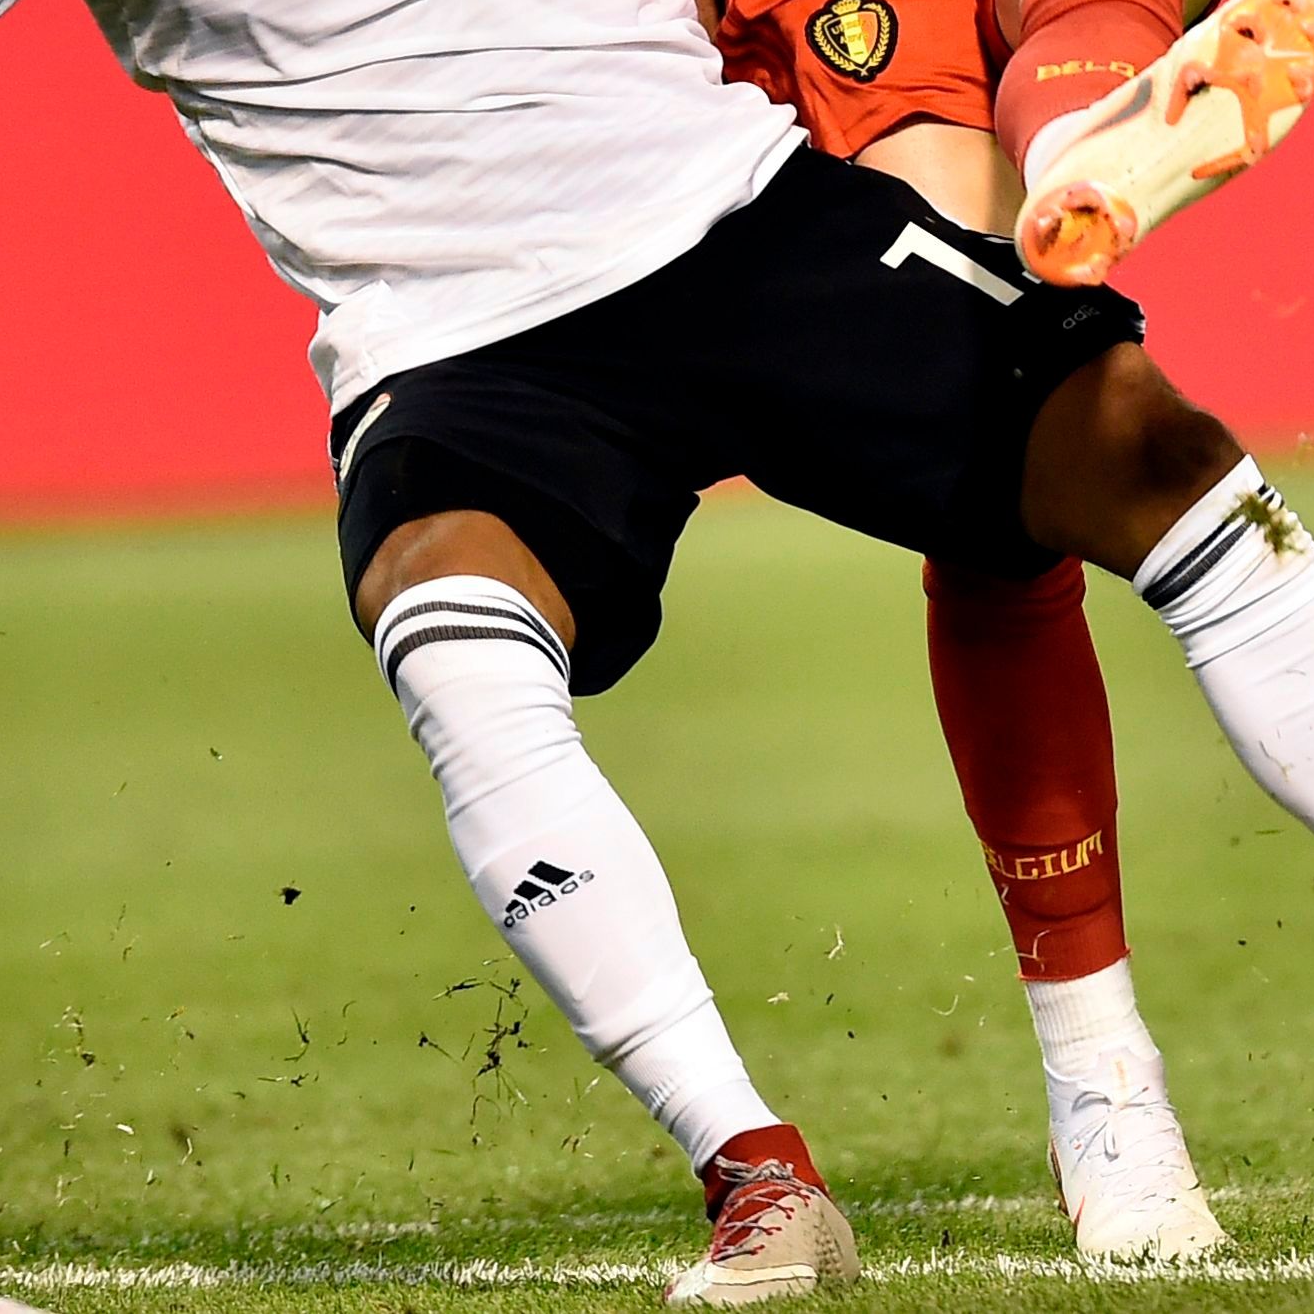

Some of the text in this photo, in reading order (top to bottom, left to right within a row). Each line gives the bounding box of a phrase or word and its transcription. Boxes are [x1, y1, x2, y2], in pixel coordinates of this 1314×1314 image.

[1036, 60, 1135, 82] BELG
[879, 221, 1043, 306] 1
[503, 869, 595, 928] adidas
